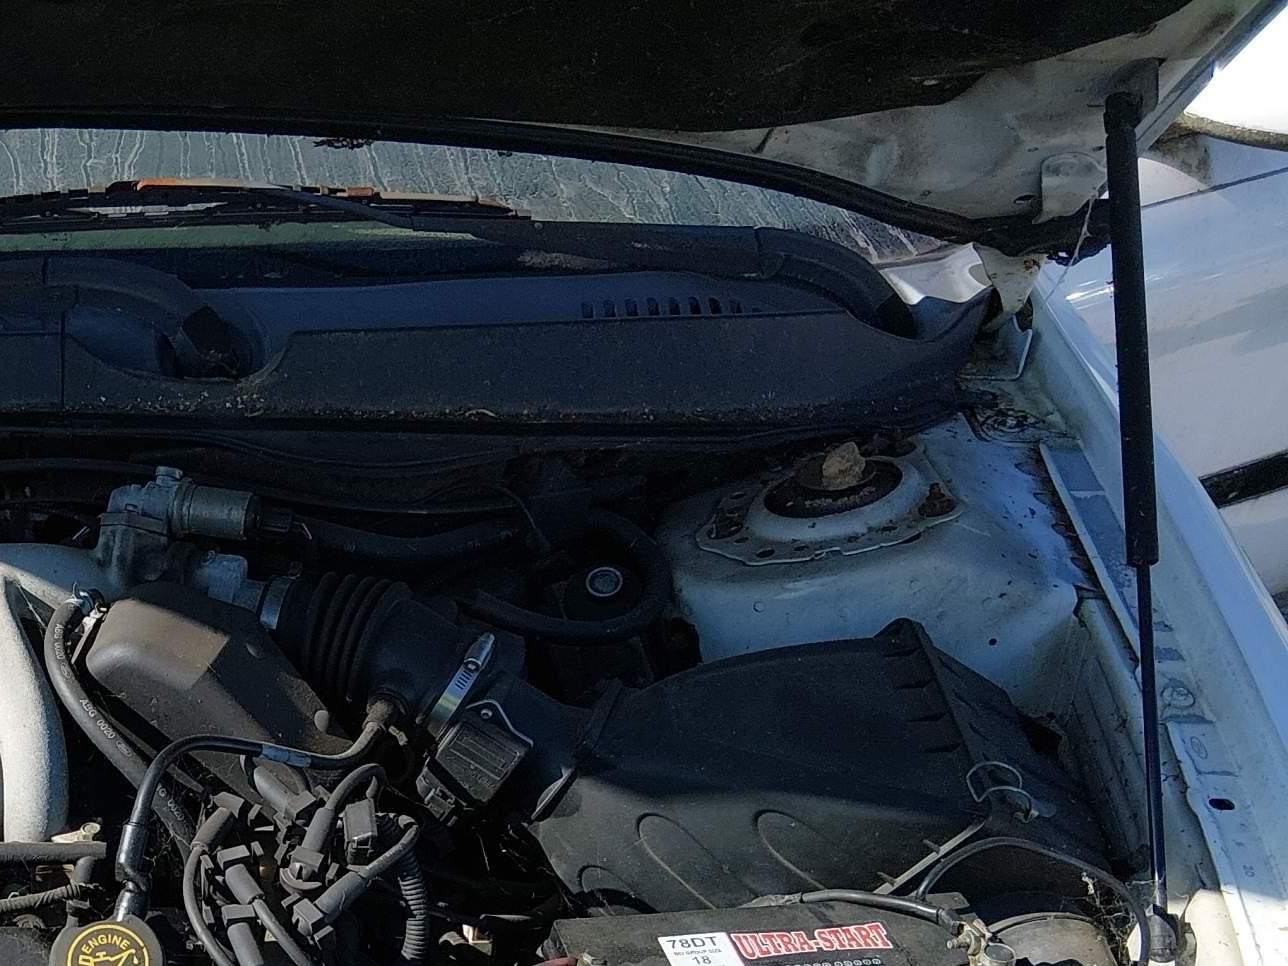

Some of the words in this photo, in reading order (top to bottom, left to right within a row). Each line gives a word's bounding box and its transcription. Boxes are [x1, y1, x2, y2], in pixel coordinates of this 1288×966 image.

[96, 719, 116, 739] 0020
[81, 934, 130, 954] ENGINE
[666, 936, 717, 949] 78DT
[730, 922, 893, 959] ULTRA-START
[692, 955, 712, 965] 18
